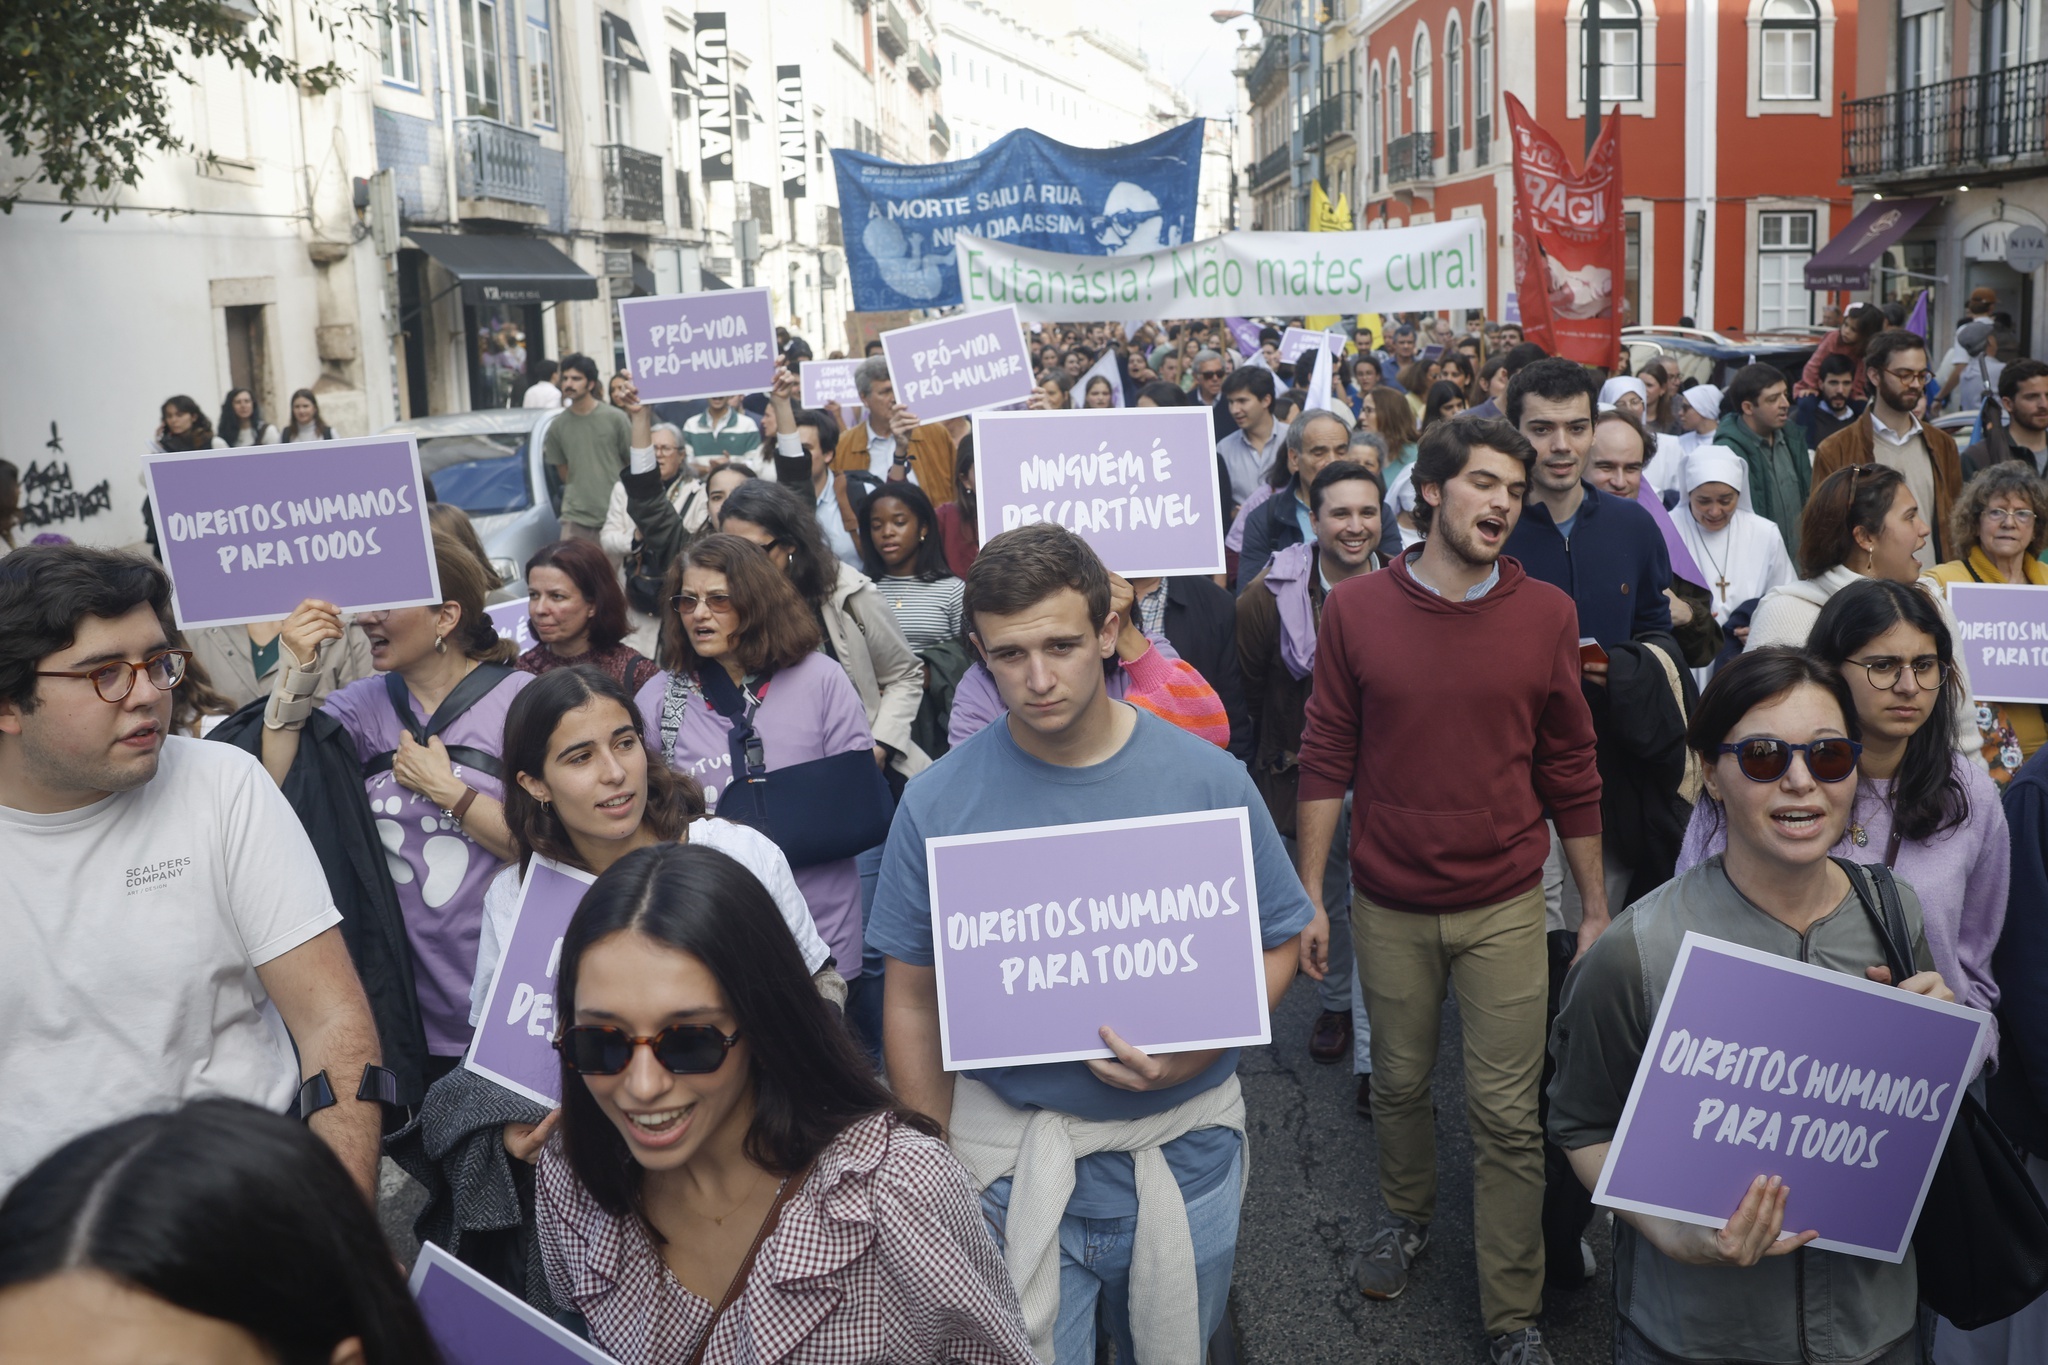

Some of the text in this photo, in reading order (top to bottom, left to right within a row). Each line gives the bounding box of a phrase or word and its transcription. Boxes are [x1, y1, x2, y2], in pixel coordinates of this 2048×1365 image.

[695, 29, 732, 160] UZINA
[776, 77, 806, 183] UZINA
[867, 202, 882, 220] A
[886, 197, 971, 220] MORTE
[976, 186, 1020, 212] SAIU
[1041, 184, 1083, 206] RUA
[932, 223, 983, 247] NUM
[2010, 237, 2045, 250] NIVA
[968, 233, 1477, 305] Eutanásia? Não mates, cura!
[649, 314, 748, 348] PRÓ-VIDA
[911, 332, 1002, 373] PRÓ-VIDA
[637, 341, 769, 379] PRÓ-MULHER
[903, 354, 1023, 403] PRÓ-MULHER
[1020, 437, 1172, 494] NINGUÉM É
[167, 484, 413, 542] DIREITOS HUMANOS
[216, 526, 382, 574] PARA TODOS
[1981, 646, 2029, 666] PARA
[126, 856, 191, 878] SCALPERS
[126, 867, 184, 888] COMPANY
[144, 883, 168, 893] DESIGN
[947, 876, 1240, 951] DIREITOS HUMANOS
[999, 933, 1199, 995] PARA TODOS
[1659, 1028, 1951, 1122] DIREITOS HUMANOS
[1692, 1097, 1890, 1169] PARA TODOS
